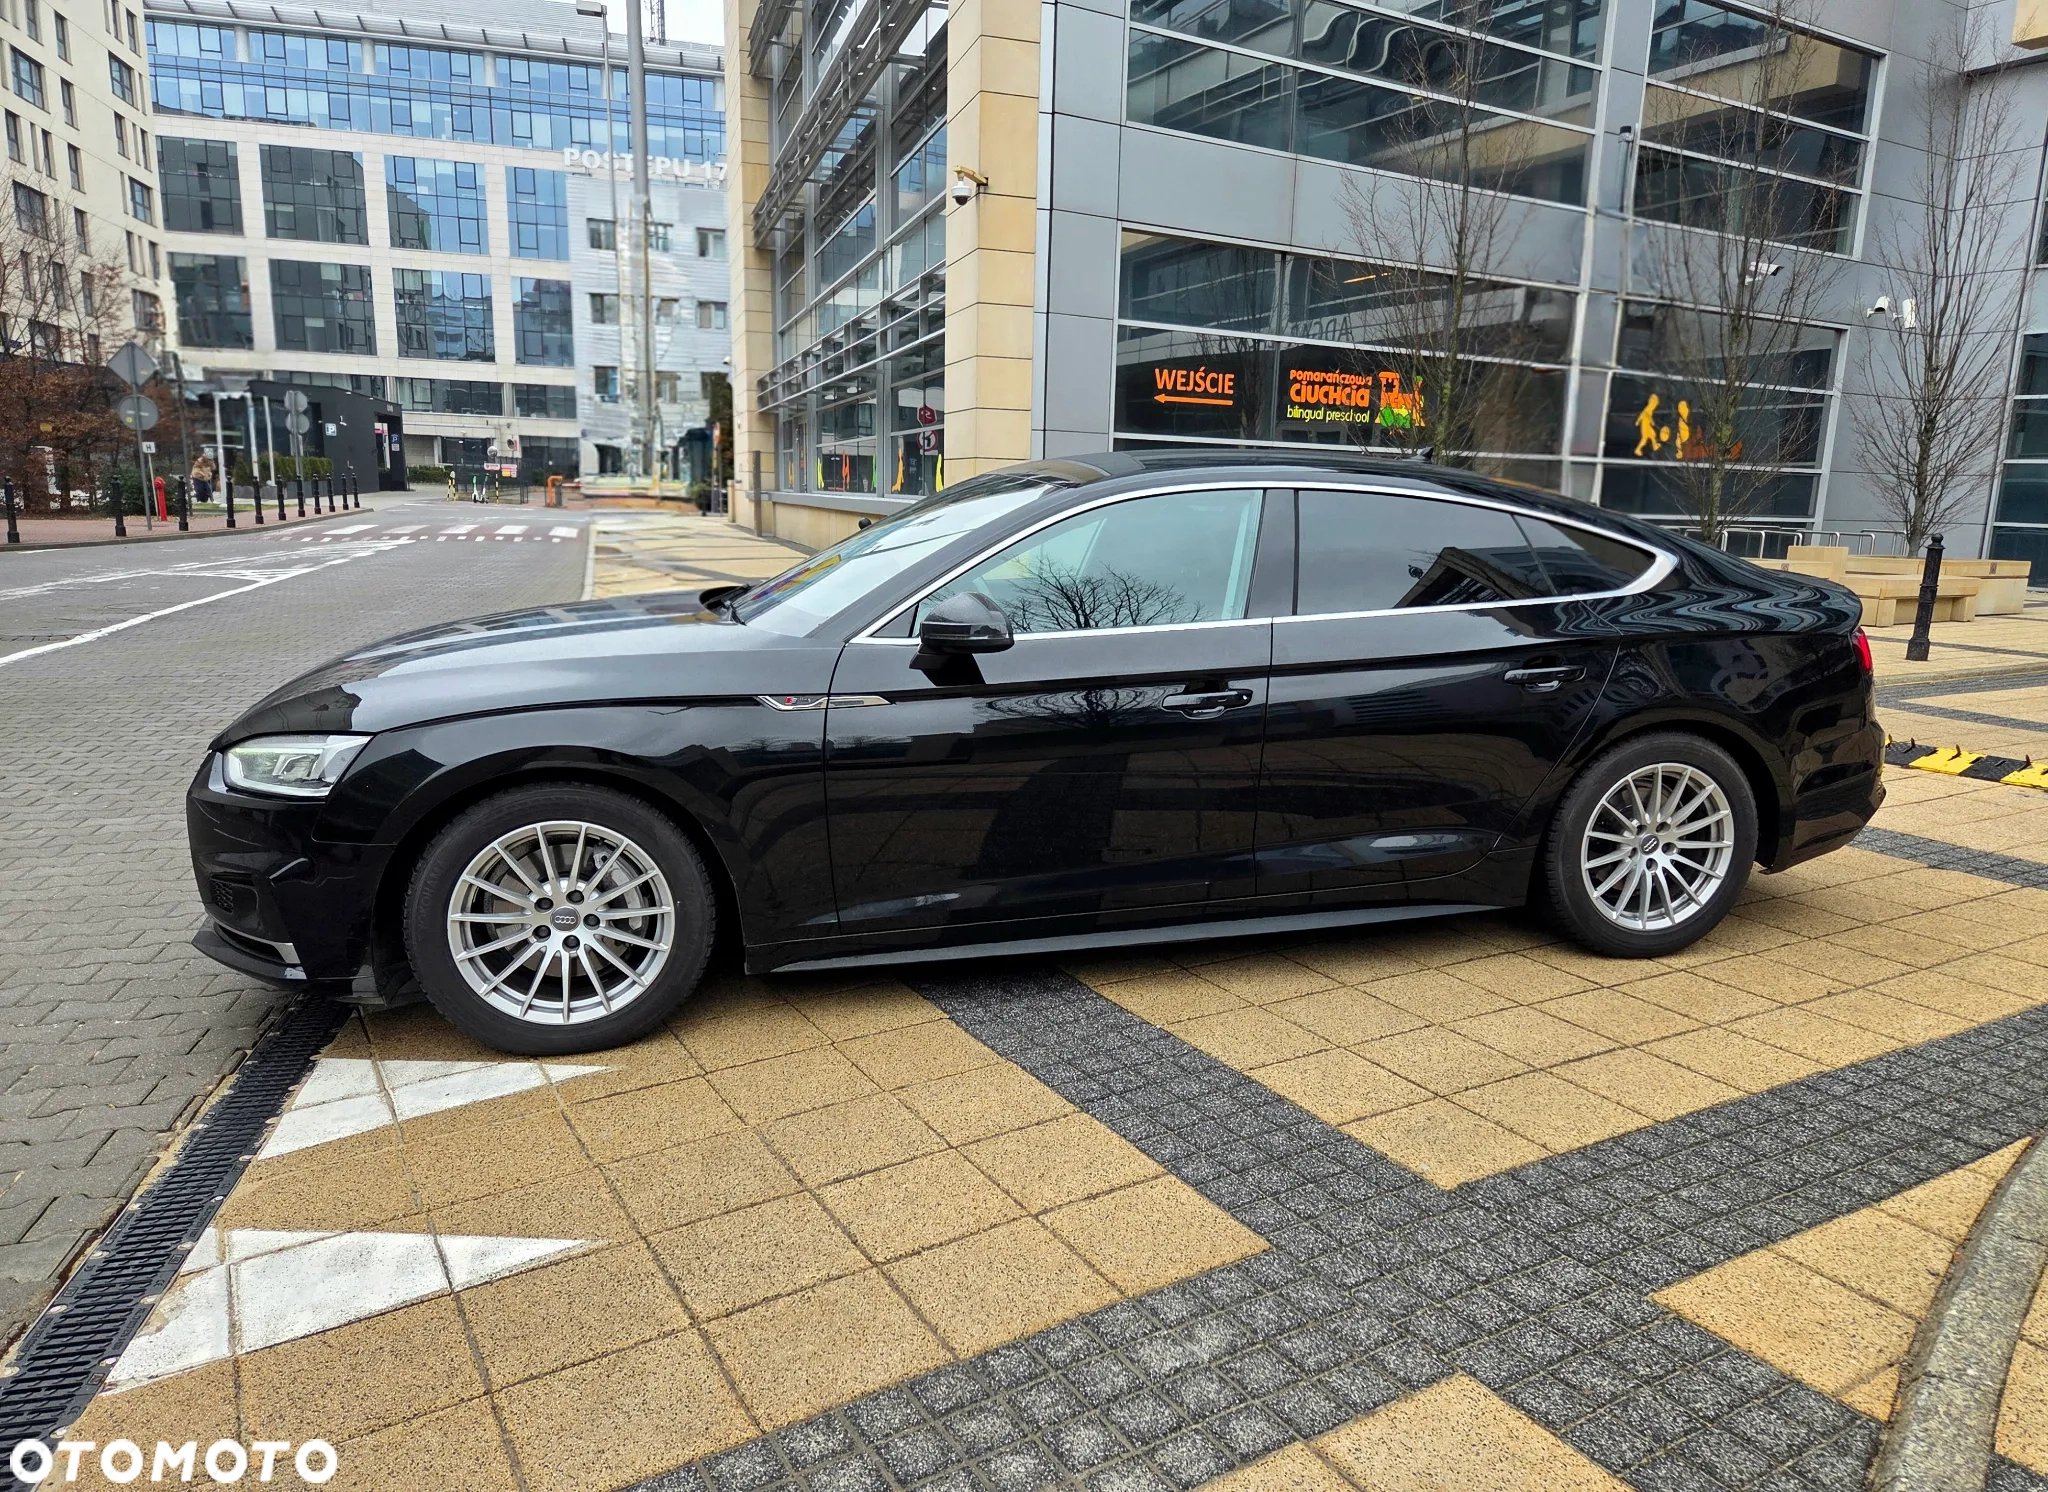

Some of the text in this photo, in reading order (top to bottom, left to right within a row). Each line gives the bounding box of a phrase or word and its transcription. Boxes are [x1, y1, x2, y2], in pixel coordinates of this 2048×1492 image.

[700, 161, 728, 180] 17
[1154, 366, 1235, 395] WEJŚCIE
[1287, 405, 1370, 424] bilingual preschool
[145, 443, 152, 452] H
